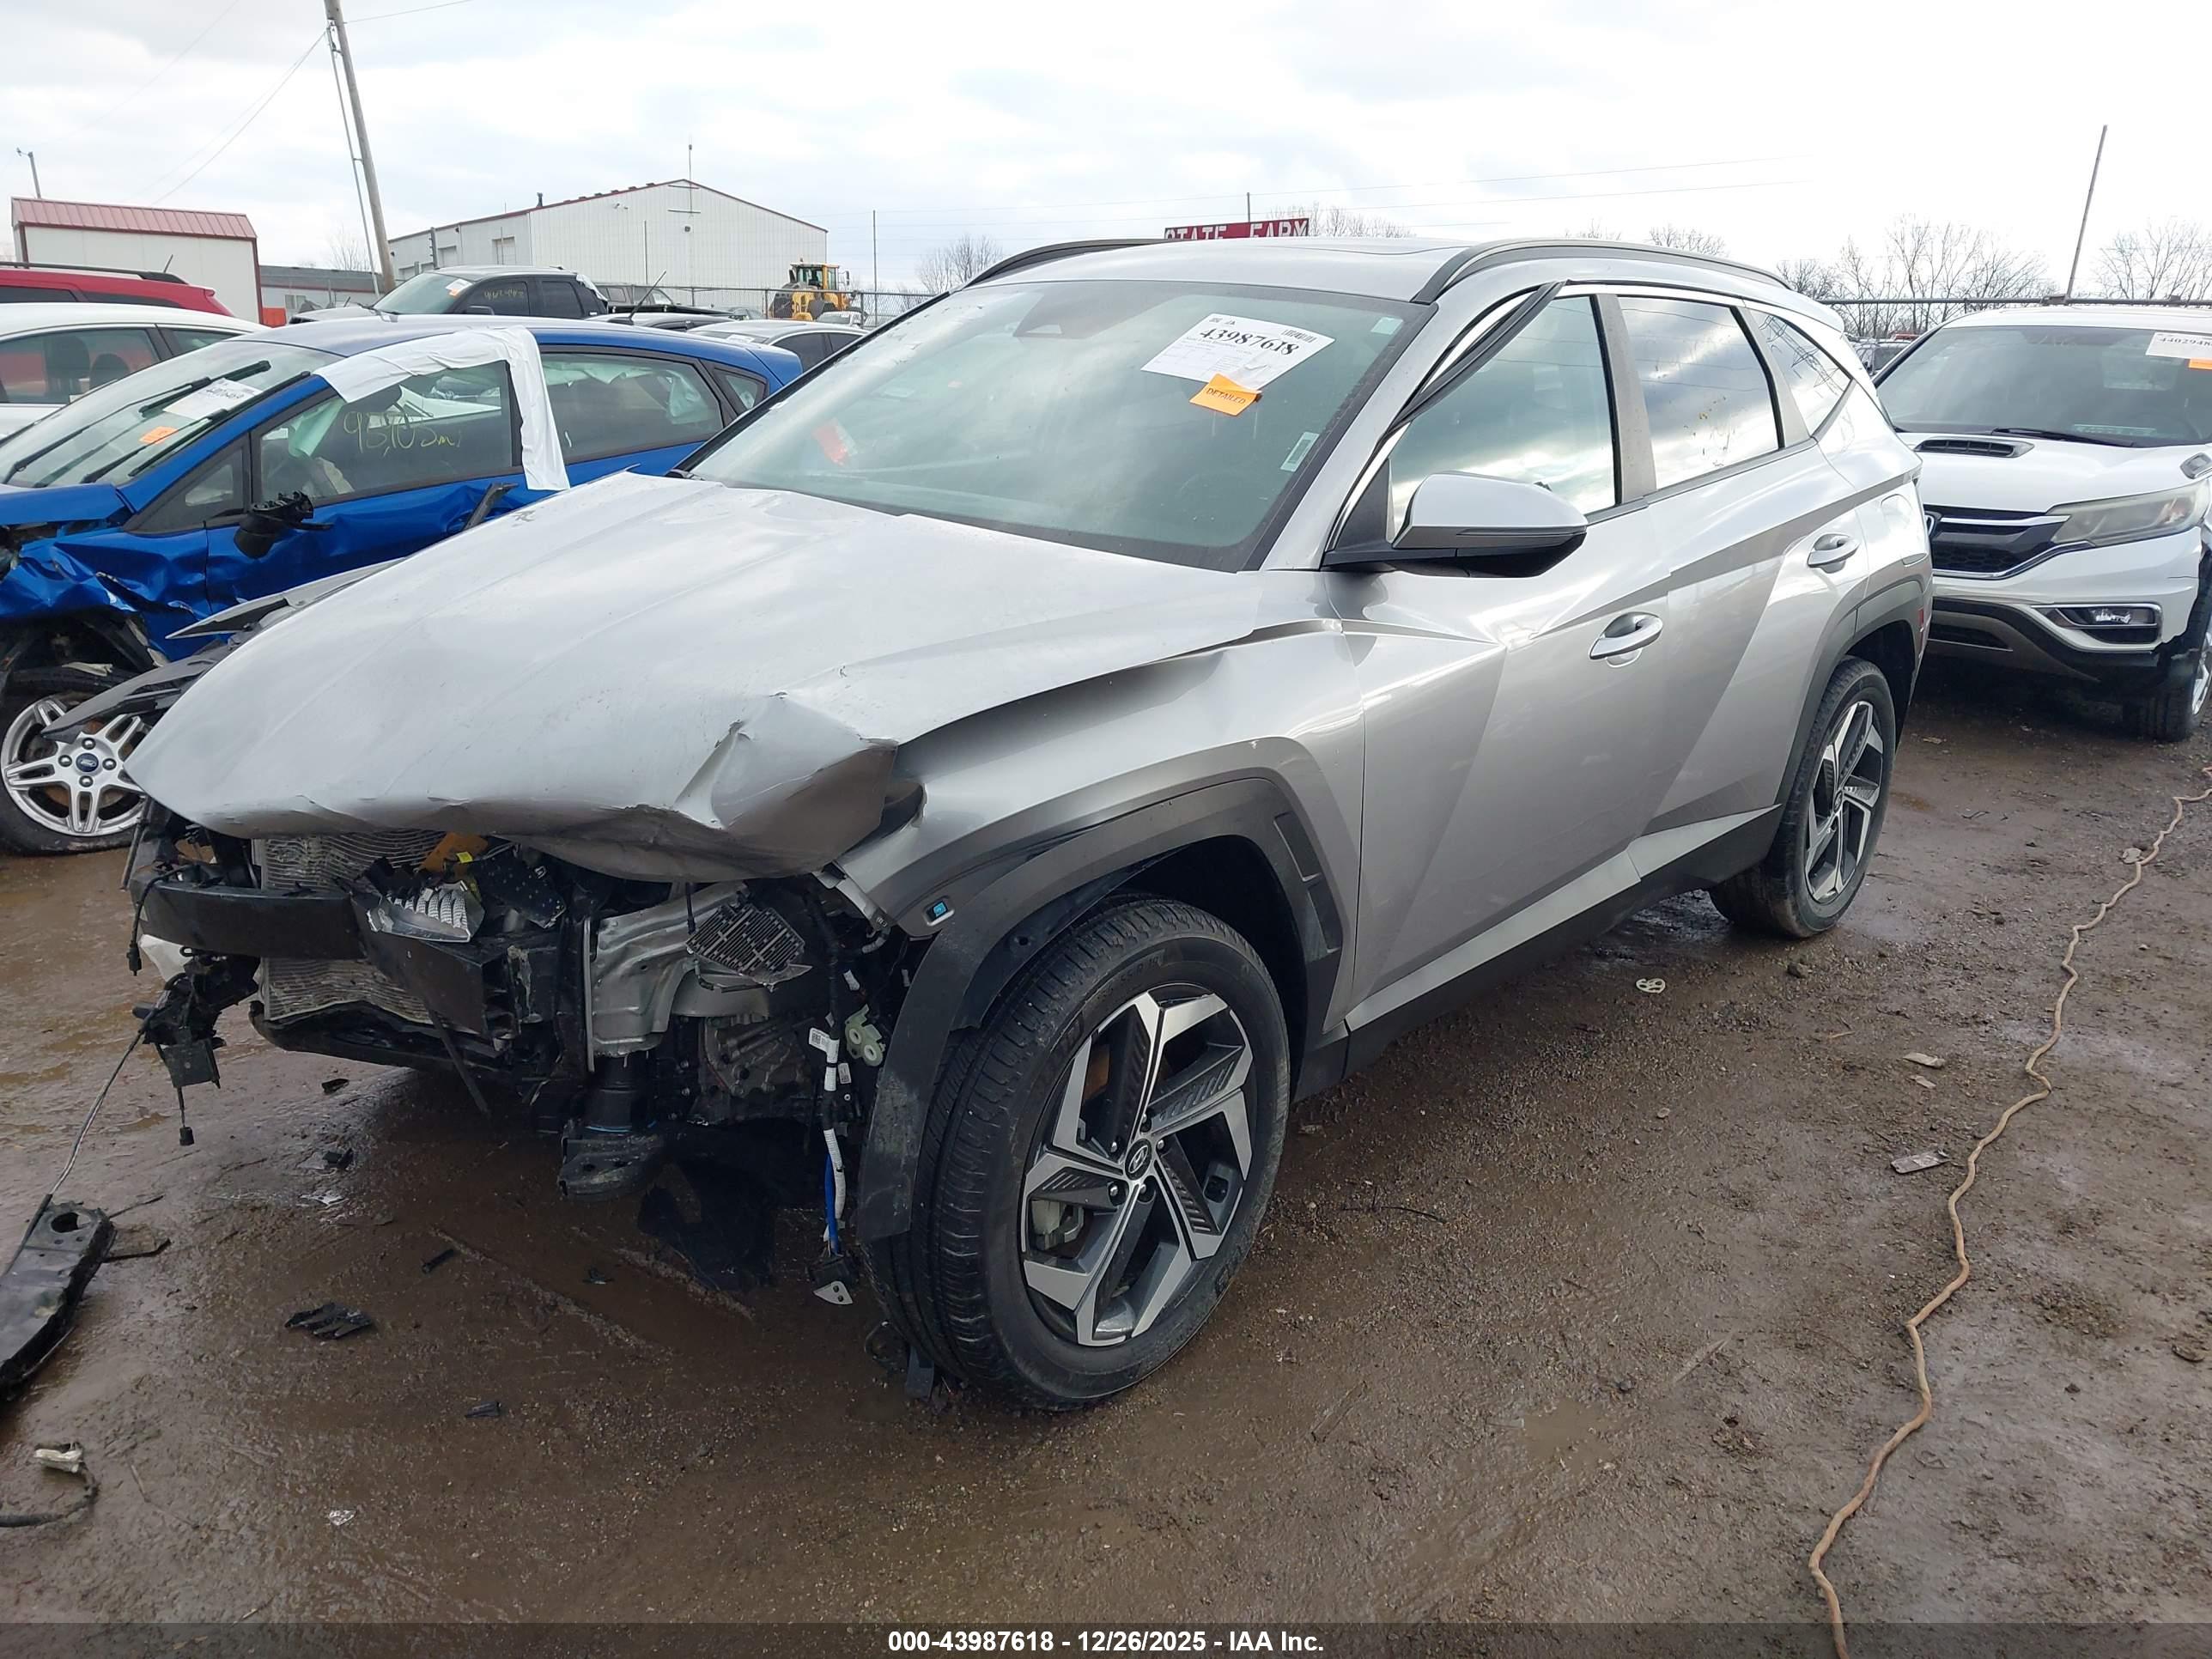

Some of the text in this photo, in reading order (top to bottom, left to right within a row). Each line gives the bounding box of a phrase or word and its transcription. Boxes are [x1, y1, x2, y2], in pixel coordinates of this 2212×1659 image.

[1200, 328, 1299, 355] 43987618
[2159, 337, 2212, 347] 4402948
[1206, 387, 1246, 404] DETAILED
